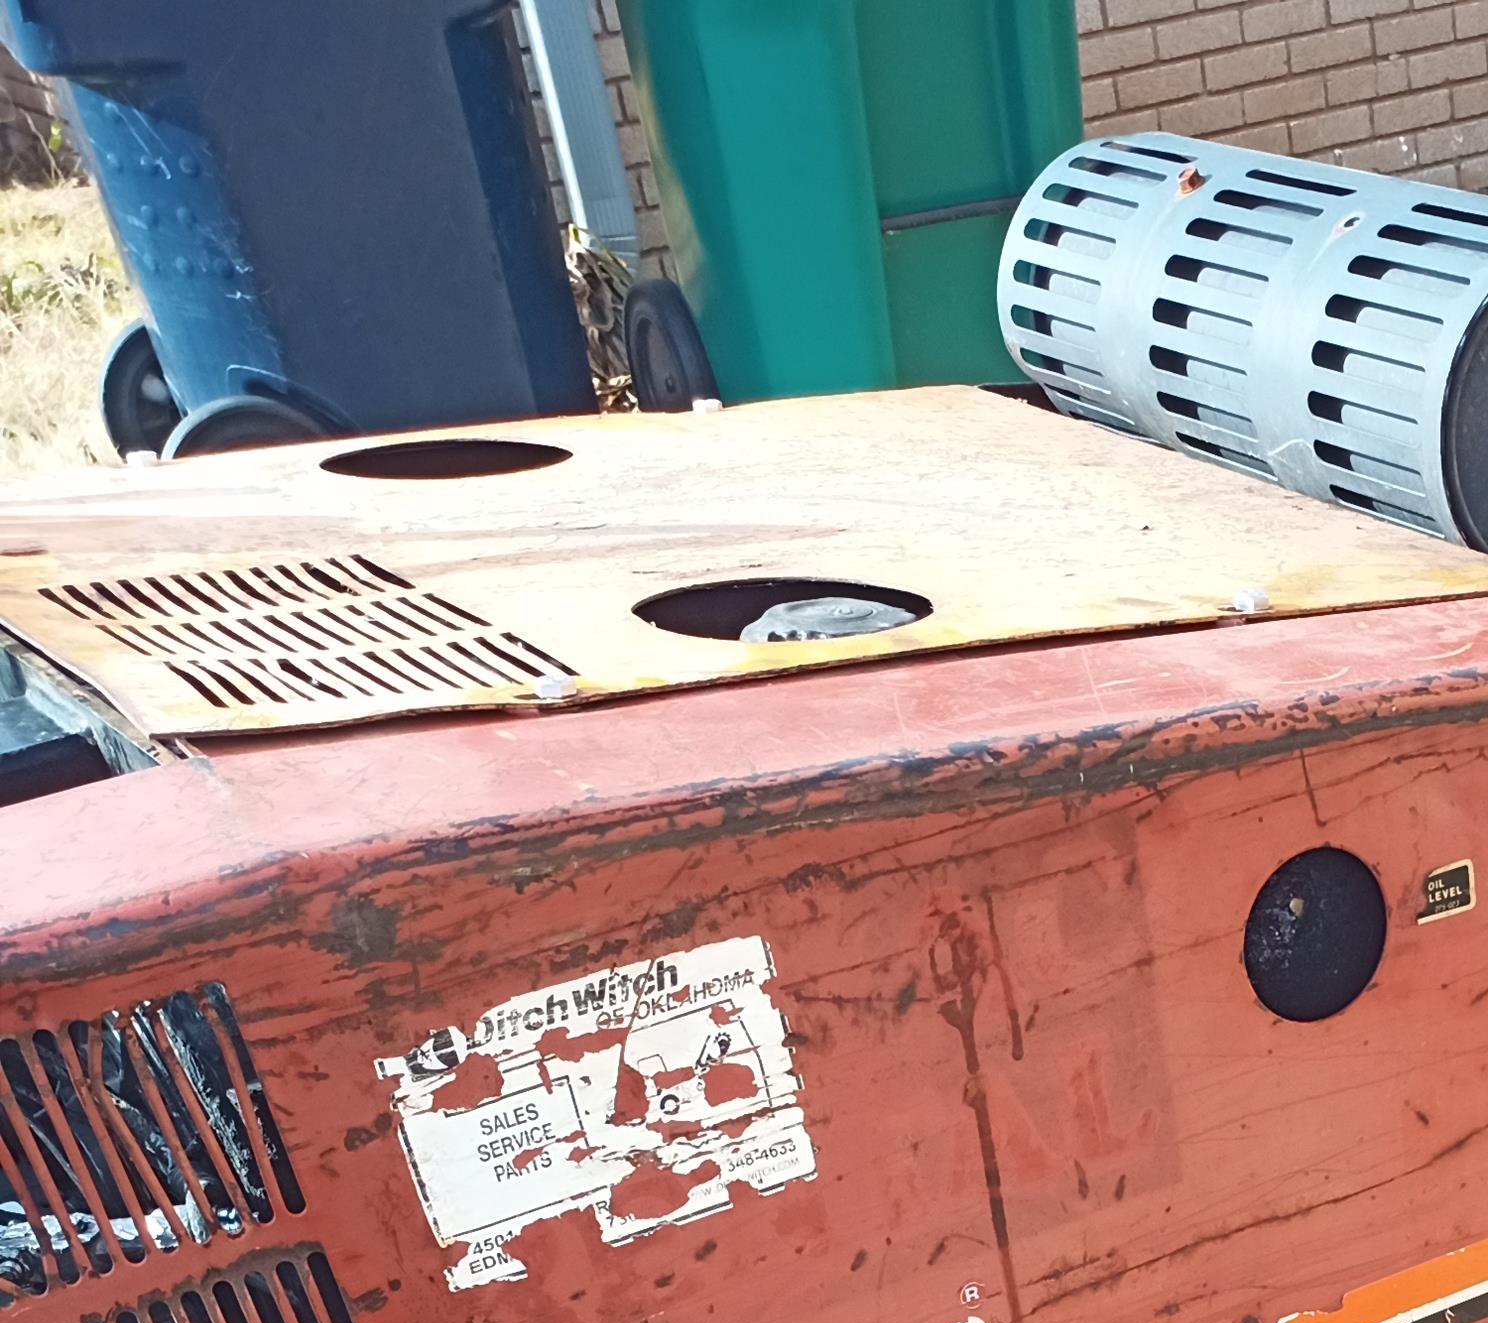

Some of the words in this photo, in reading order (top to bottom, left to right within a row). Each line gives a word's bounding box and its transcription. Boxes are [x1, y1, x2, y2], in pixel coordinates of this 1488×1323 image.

[1427, 879, 1445, 891] OIL
[1428, 886, 1463, 903] LEVEL
[572, 960, 678, 1014] Witch
[635, 968, 756, 1021] OKLAHOMA
[479, 1103, 539, 1136] SALES
[477, 1122, 556, 1163] SERVICE
